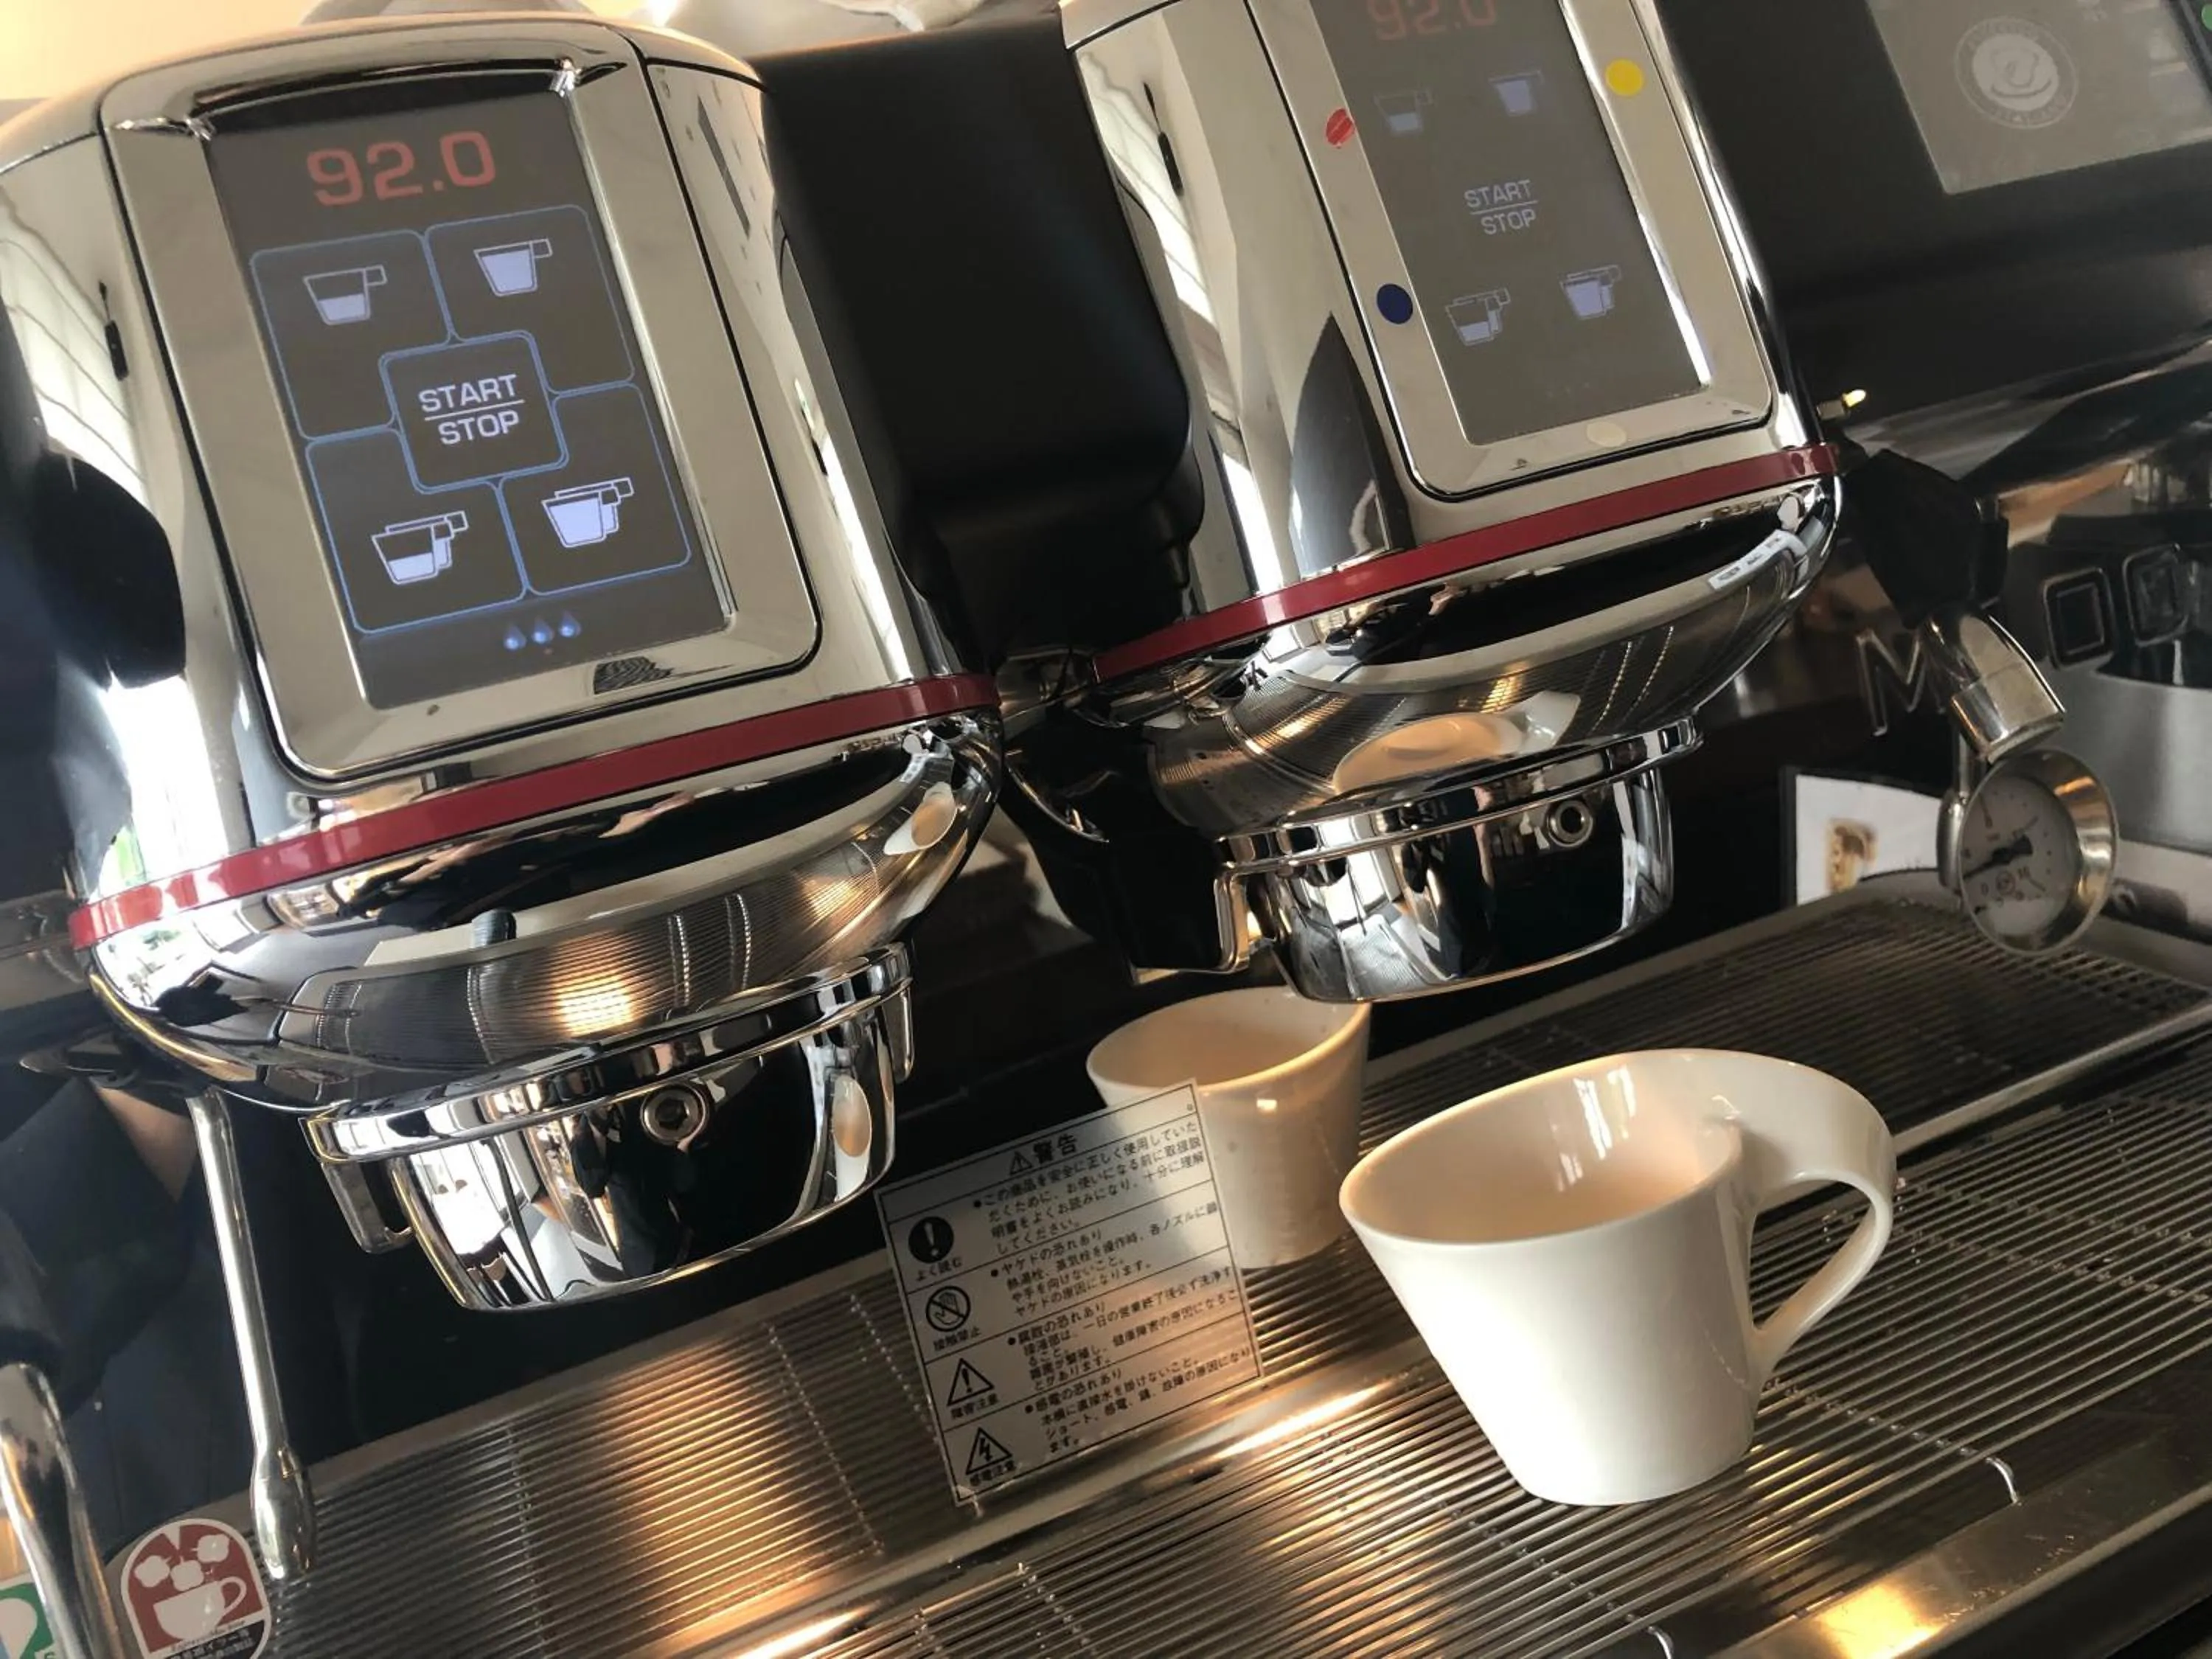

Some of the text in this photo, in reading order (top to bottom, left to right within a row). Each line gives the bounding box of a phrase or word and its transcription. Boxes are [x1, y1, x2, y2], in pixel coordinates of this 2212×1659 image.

[1367, 0, 1497, 40] 92.0
[306, 131, 495, 206] 92.0
[1464, 180, 1531, 209] START
[1481, 209, 1537, 235] STOP
[418, 374, 517, 413] START
[438, 410, 519, 445] STOP
[1032, 1129, 1079, 1166] 警告
[913, 1253, 964, 1284] よく読む
